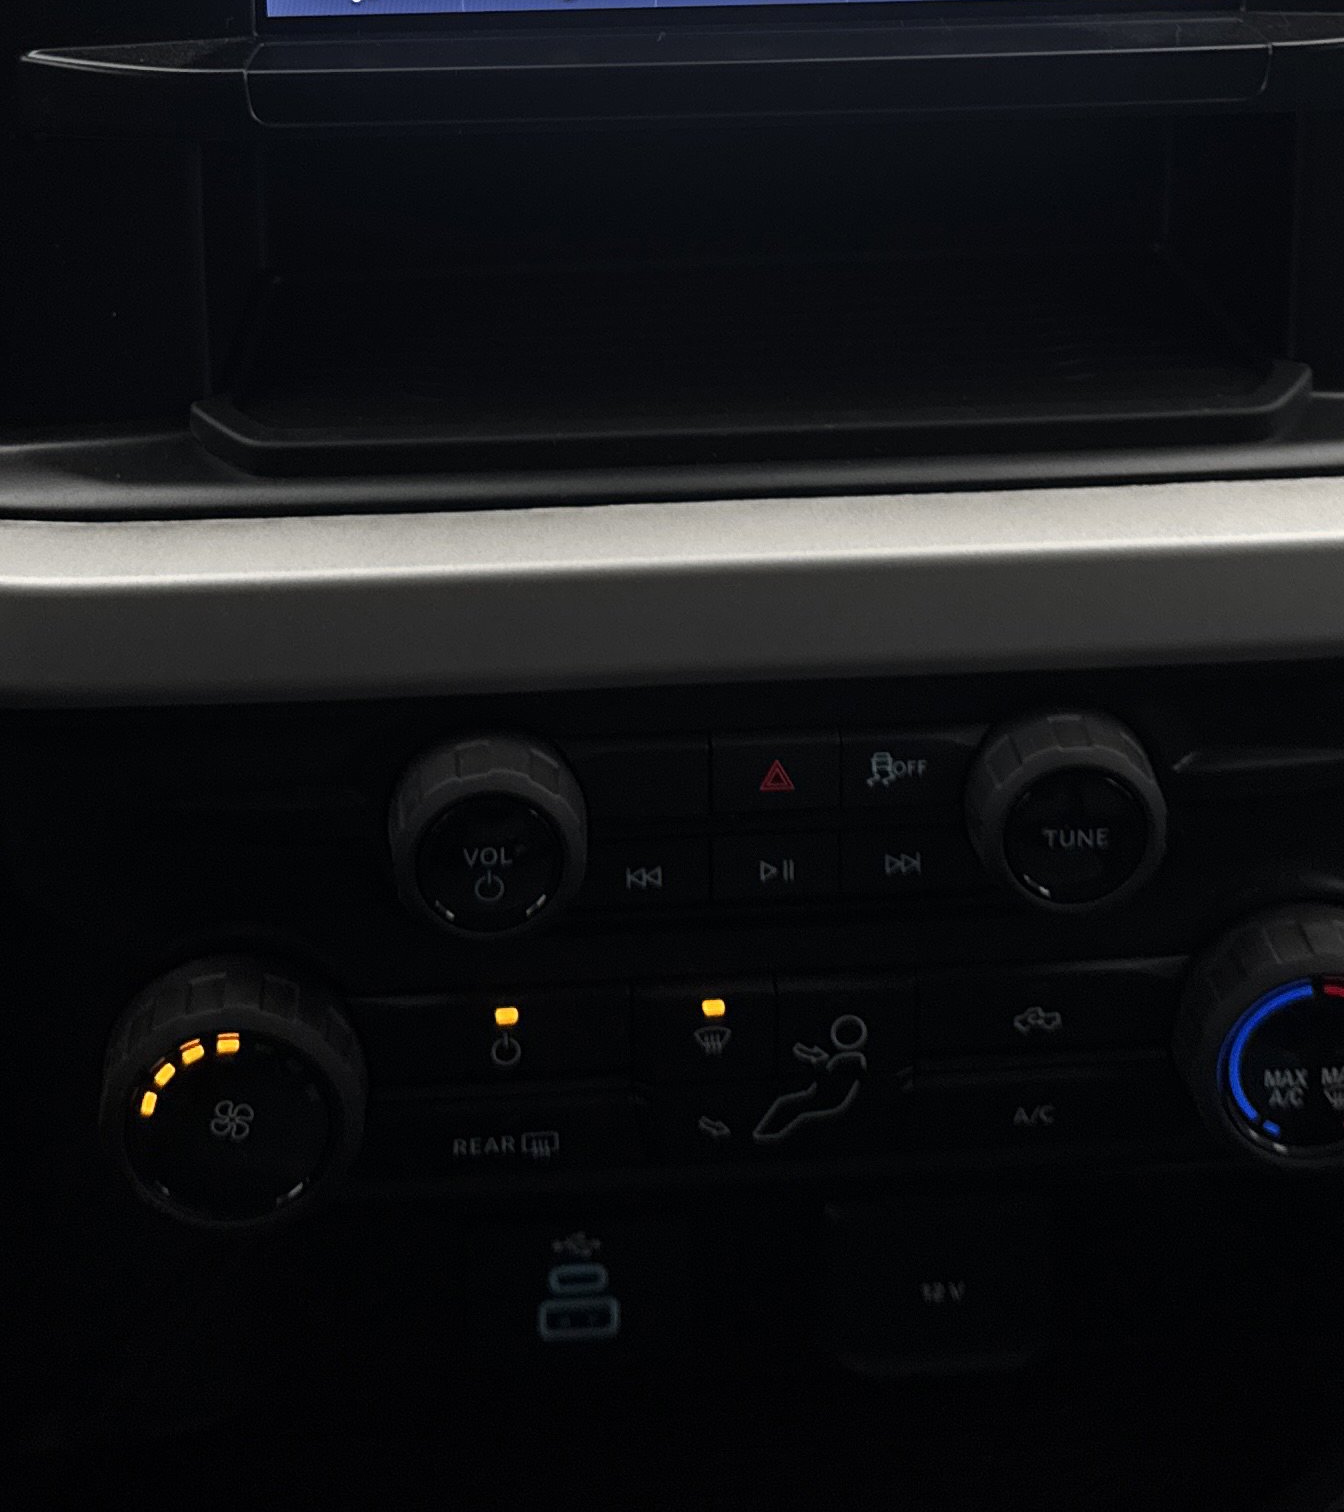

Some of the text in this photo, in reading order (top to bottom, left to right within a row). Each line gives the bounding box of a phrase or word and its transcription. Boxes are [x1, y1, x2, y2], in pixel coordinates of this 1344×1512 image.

[893, 759, 928, 778] OFF
[1041, 827, 1110, 850] TUNE
[462, 845, 513, 867] VOL
[1263, 1067, 1309, 1088] MAX
[1268, 1087, 1305, 1109] A/C
[1013, 1104, 1054, 1127] A/C
[452, 1135, 516, 1157] REAR
